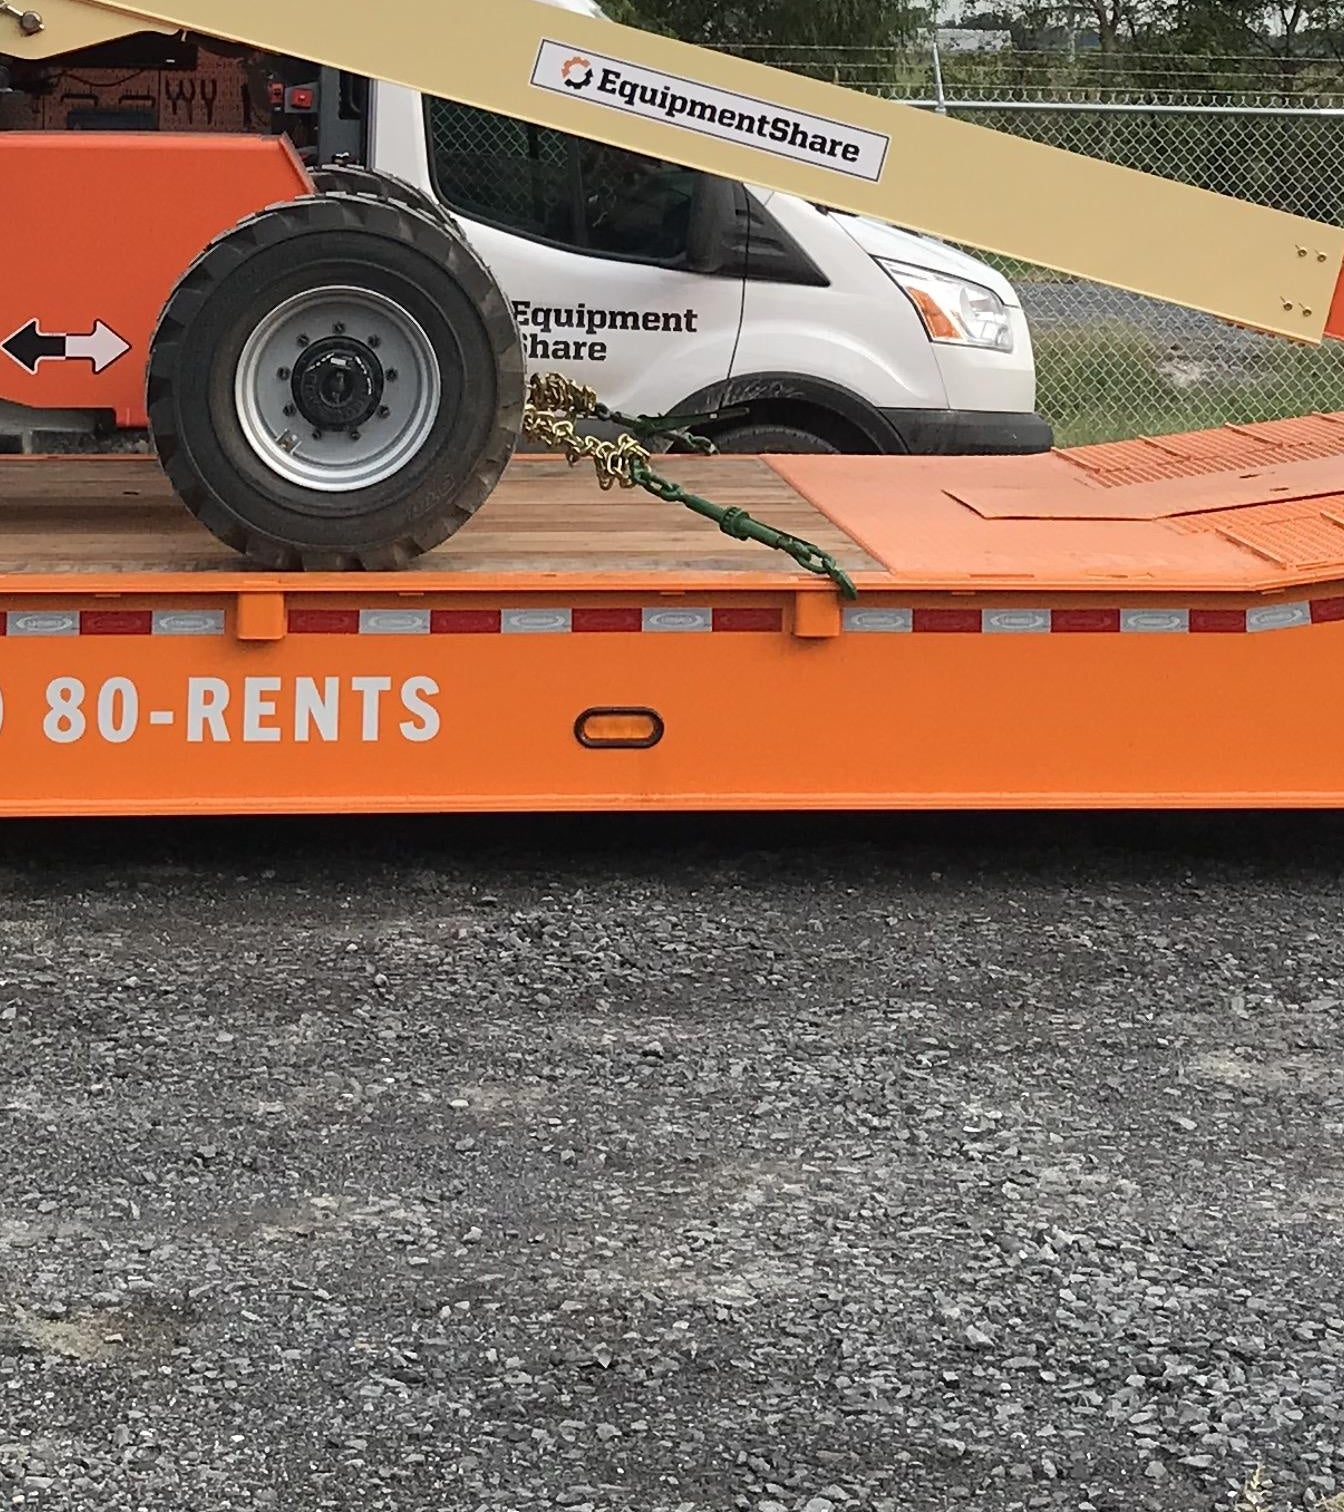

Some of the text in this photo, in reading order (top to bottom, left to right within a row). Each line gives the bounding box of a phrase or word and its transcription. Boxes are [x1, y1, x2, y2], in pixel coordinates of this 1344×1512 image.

[597, 67, 860, 163] EquipmentShare
[511, 300, 698, 335] Equipment
[43, 676, 441, 742] 80-RENTS
